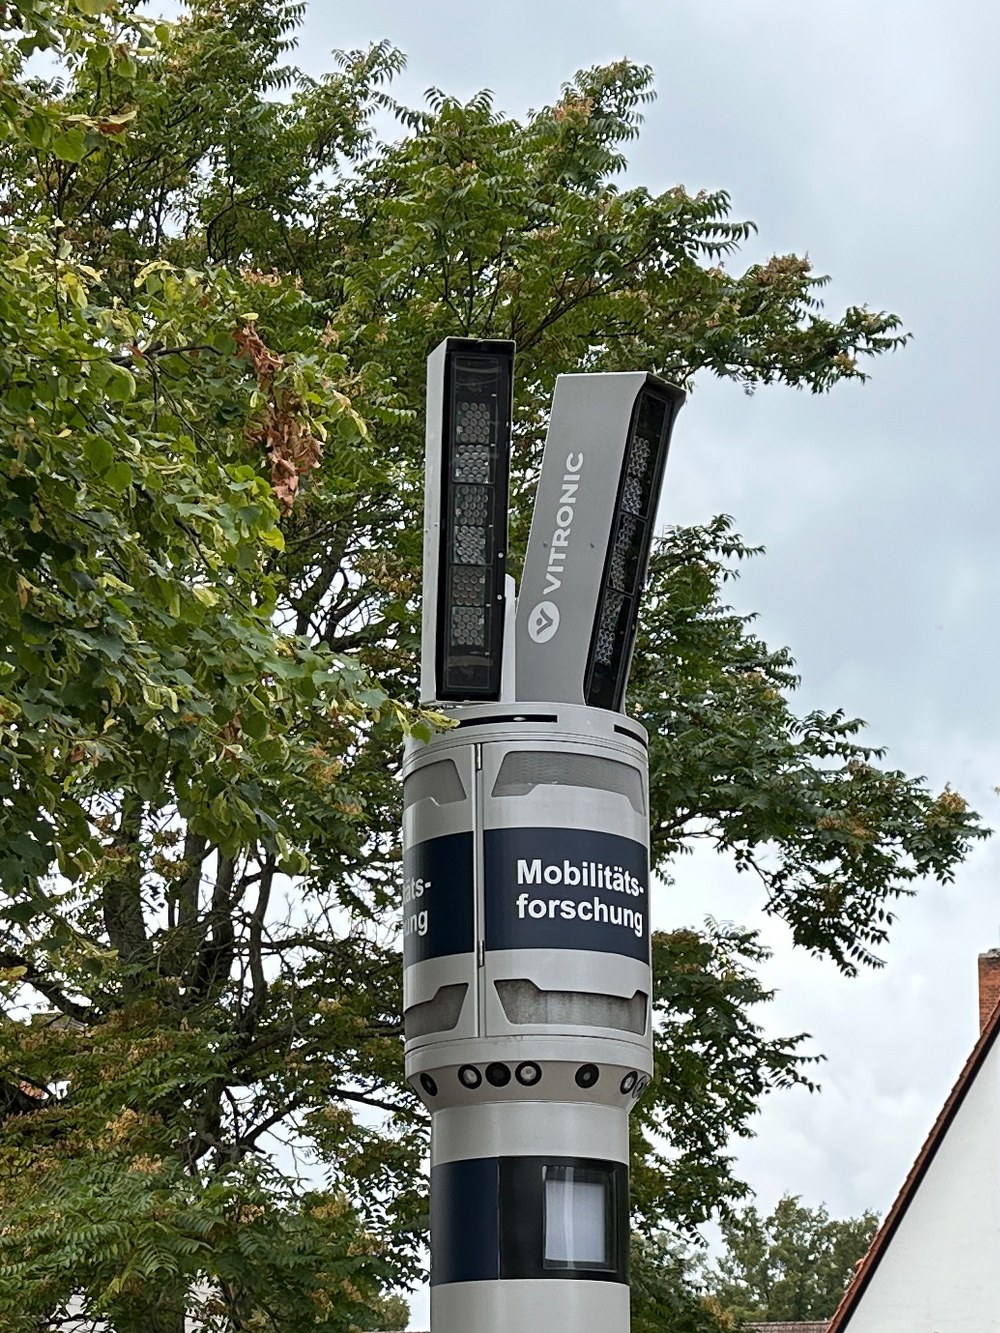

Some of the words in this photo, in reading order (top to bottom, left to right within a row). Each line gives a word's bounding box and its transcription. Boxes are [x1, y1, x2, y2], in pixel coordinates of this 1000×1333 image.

[543, 452, 584, 595] VITRONIC
[516, 858, 645, 898] Mobilitäts-
[516, 893, 644, 938] forschung
